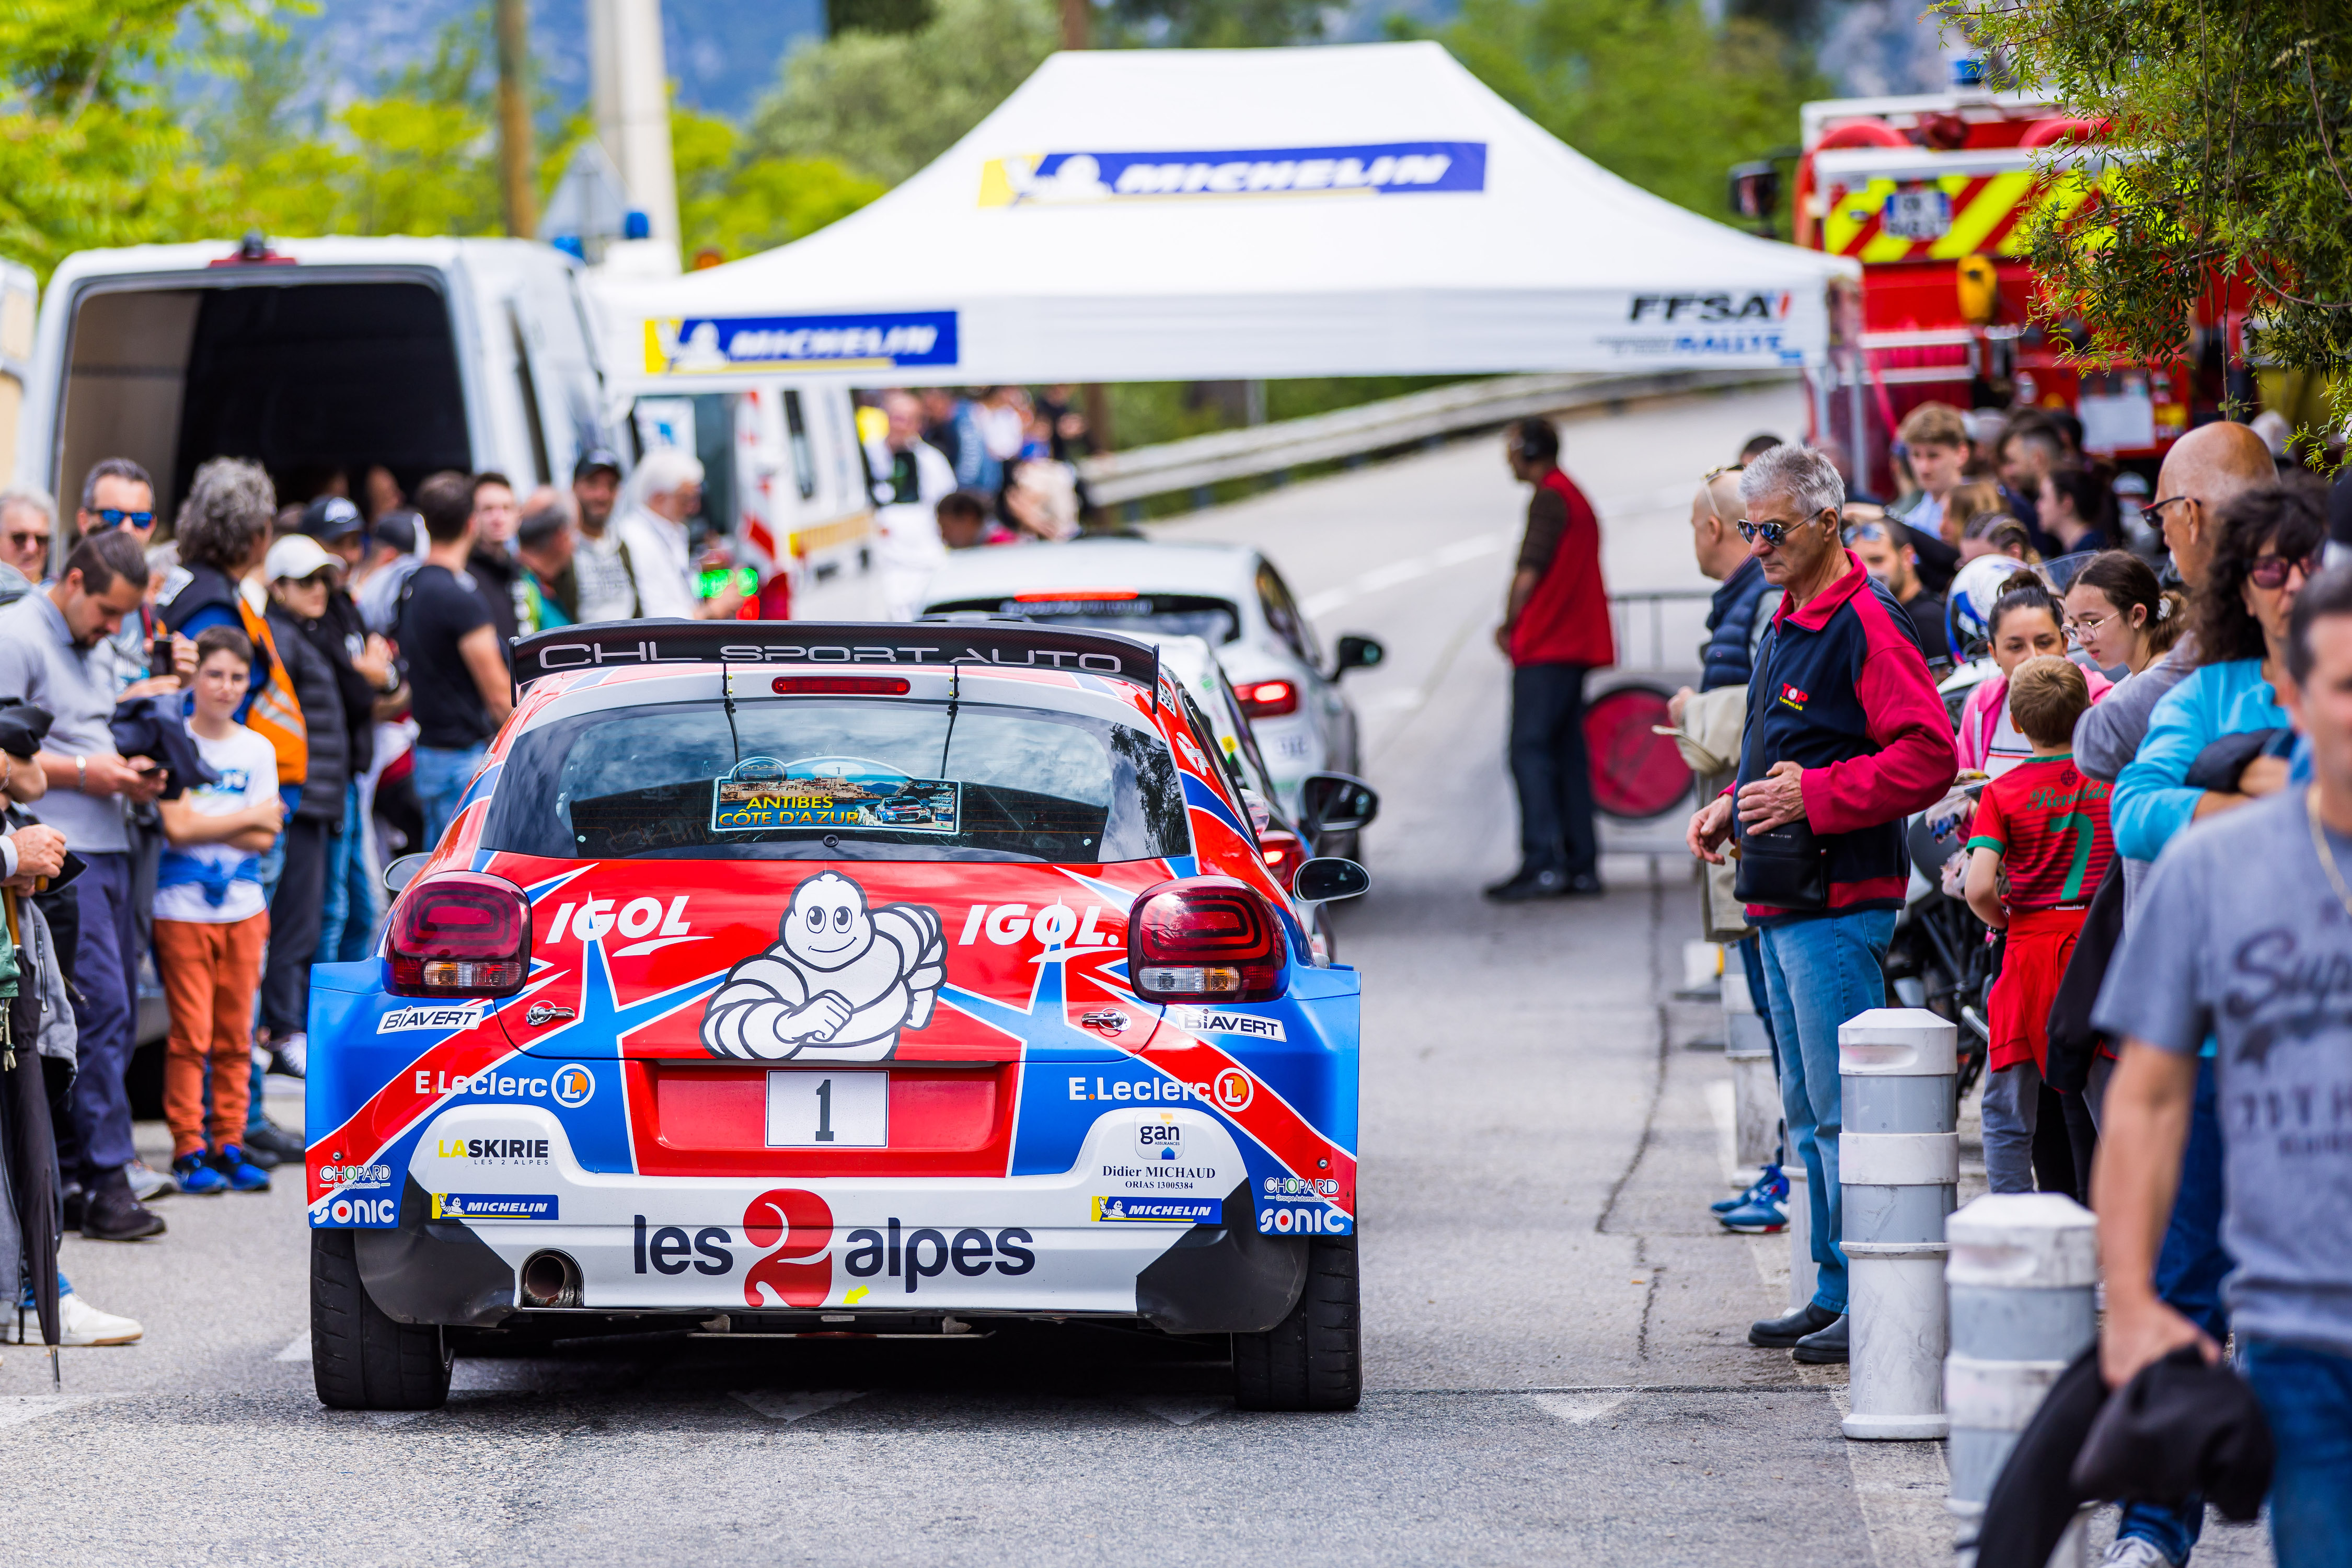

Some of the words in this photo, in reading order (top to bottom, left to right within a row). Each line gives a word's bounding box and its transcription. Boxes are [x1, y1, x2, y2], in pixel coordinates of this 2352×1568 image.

[1114, 154, 1453, 194] MICHELIN
[1630, 294, 1770, 321] FFSA
[730, 325, 939, 359] MICHELIN
[539, 641, 703, 672] CHL
[720, 644, 940, 664] SPORT
[949, 647, 1122, 674] AUTO
[1782, 683, 1808, 704] TOP
[746, 796, 834, 809] ANTIBES
[2026, 780, 2110, 811] Ronaldo
[719, 809, 772, 826] CÔTE
[779, 812, 860, 825] D'AZUR
[2049, 812, 2094, 901] 7
[546, 895, 690, 944] IGOL
[416, 1070, 548, 1096] E.Leclerc
[1069, 1077, 1212, 1102] E.Leclerc
[815, 1079, 835, 1142] 1
[1140, 1126, 1180, 1145] gan
[439, 1139, 549, 1158] LASKIRIE
[321, 1166, 390, 1180] CHOPARD
[1102, 1166, 1142, 1177] Didier
[1145, 1166, 1216, 1179] MICHAUD
[1125, 1181, 1155, 1189] ORIAS
[1265, 1178, 1339, 1193] CHOPARD
[467, 1202, 548, 1213] MICHELIN
[1128, 1205, 1212, 1216] MICHELIN
[633, 1214, 733, 1275] les
[743, 1188, 834, 1307] 2
[845, 1217, 1036, 1293] alpes
